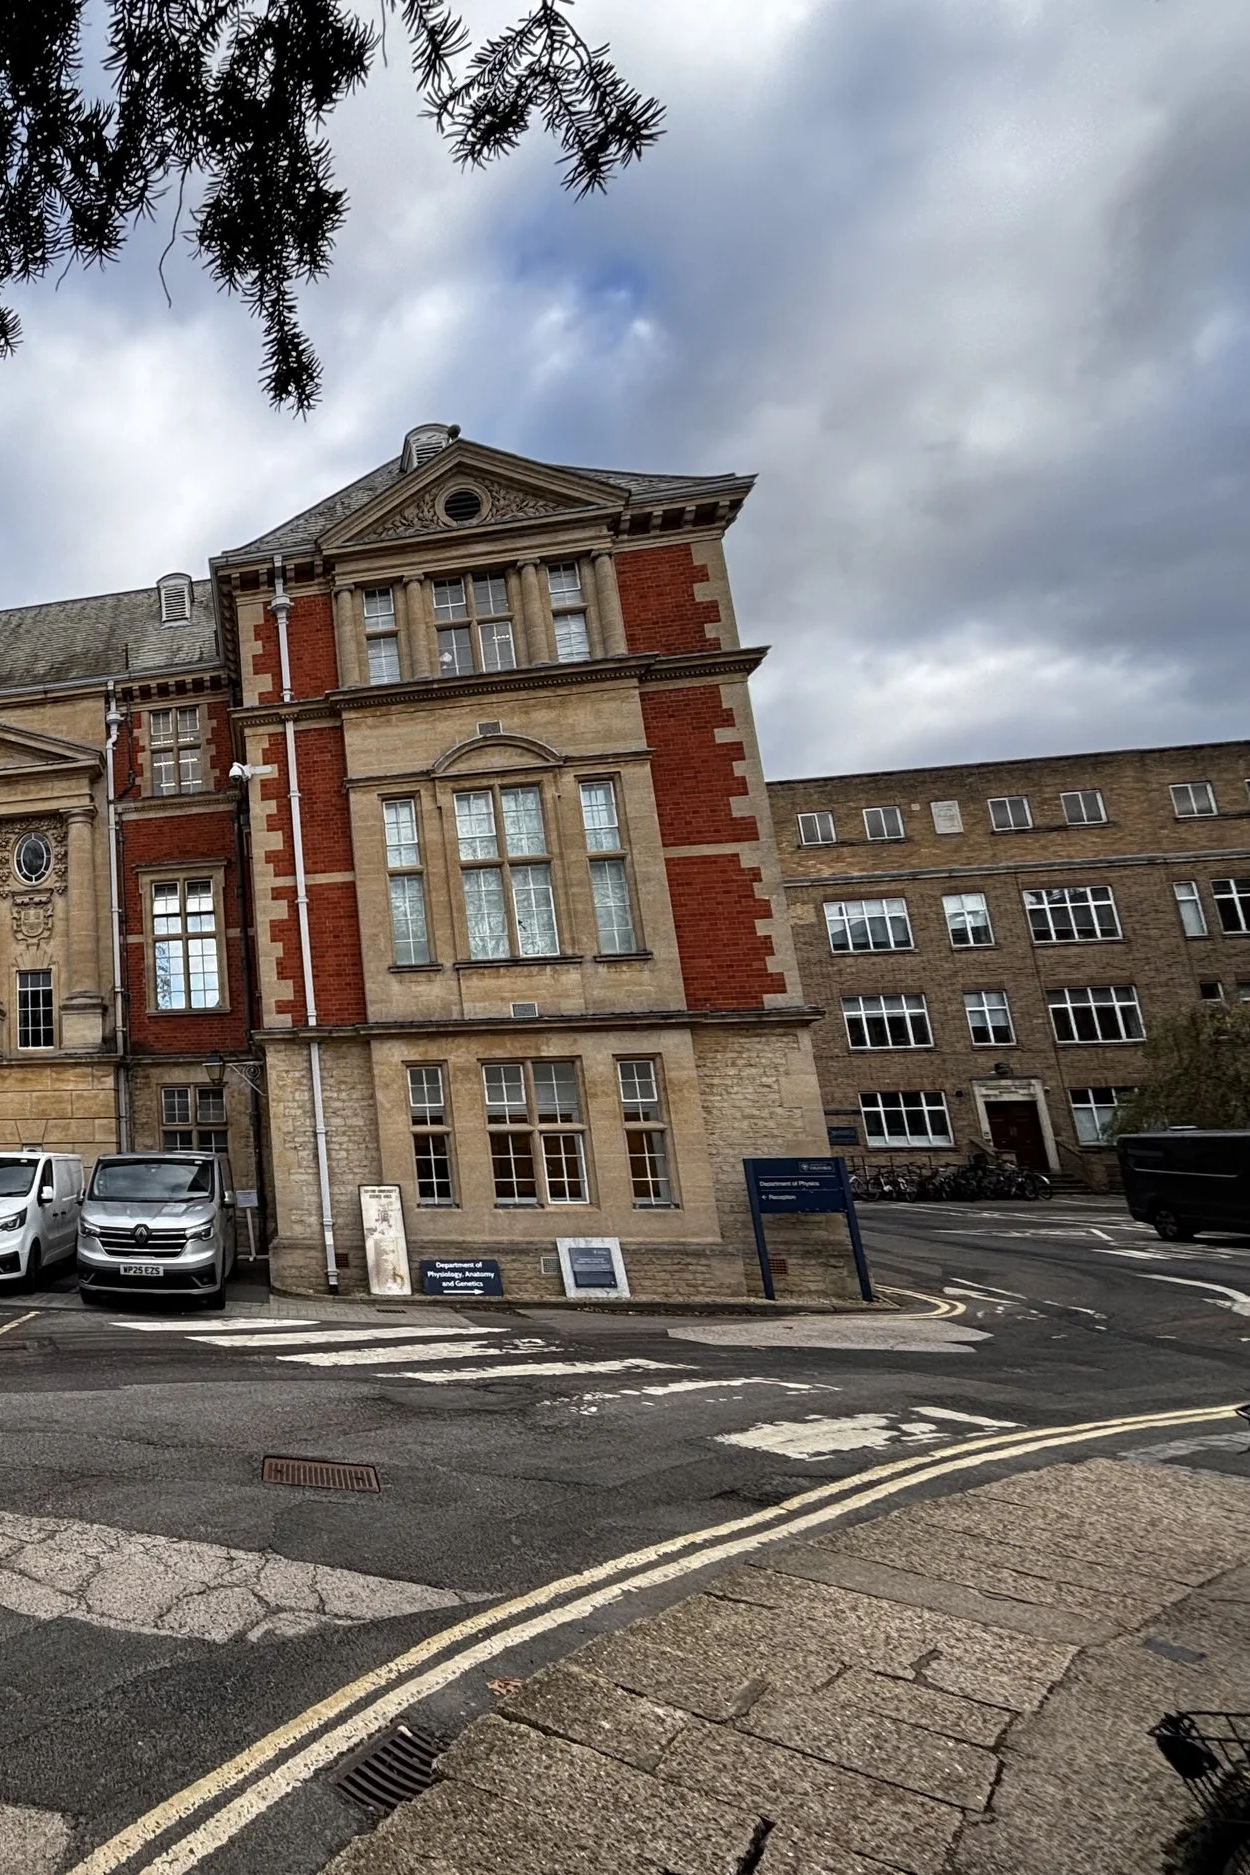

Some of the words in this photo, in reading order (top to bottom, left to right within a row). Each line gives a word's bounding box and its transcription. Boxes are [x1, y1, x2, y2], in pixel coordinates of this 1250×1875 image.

[435, 1261, 475, 1269] Department
[427, 1271, 465, 1279] Physiology,
[465, 1271, 495, 1279] Anatomy
